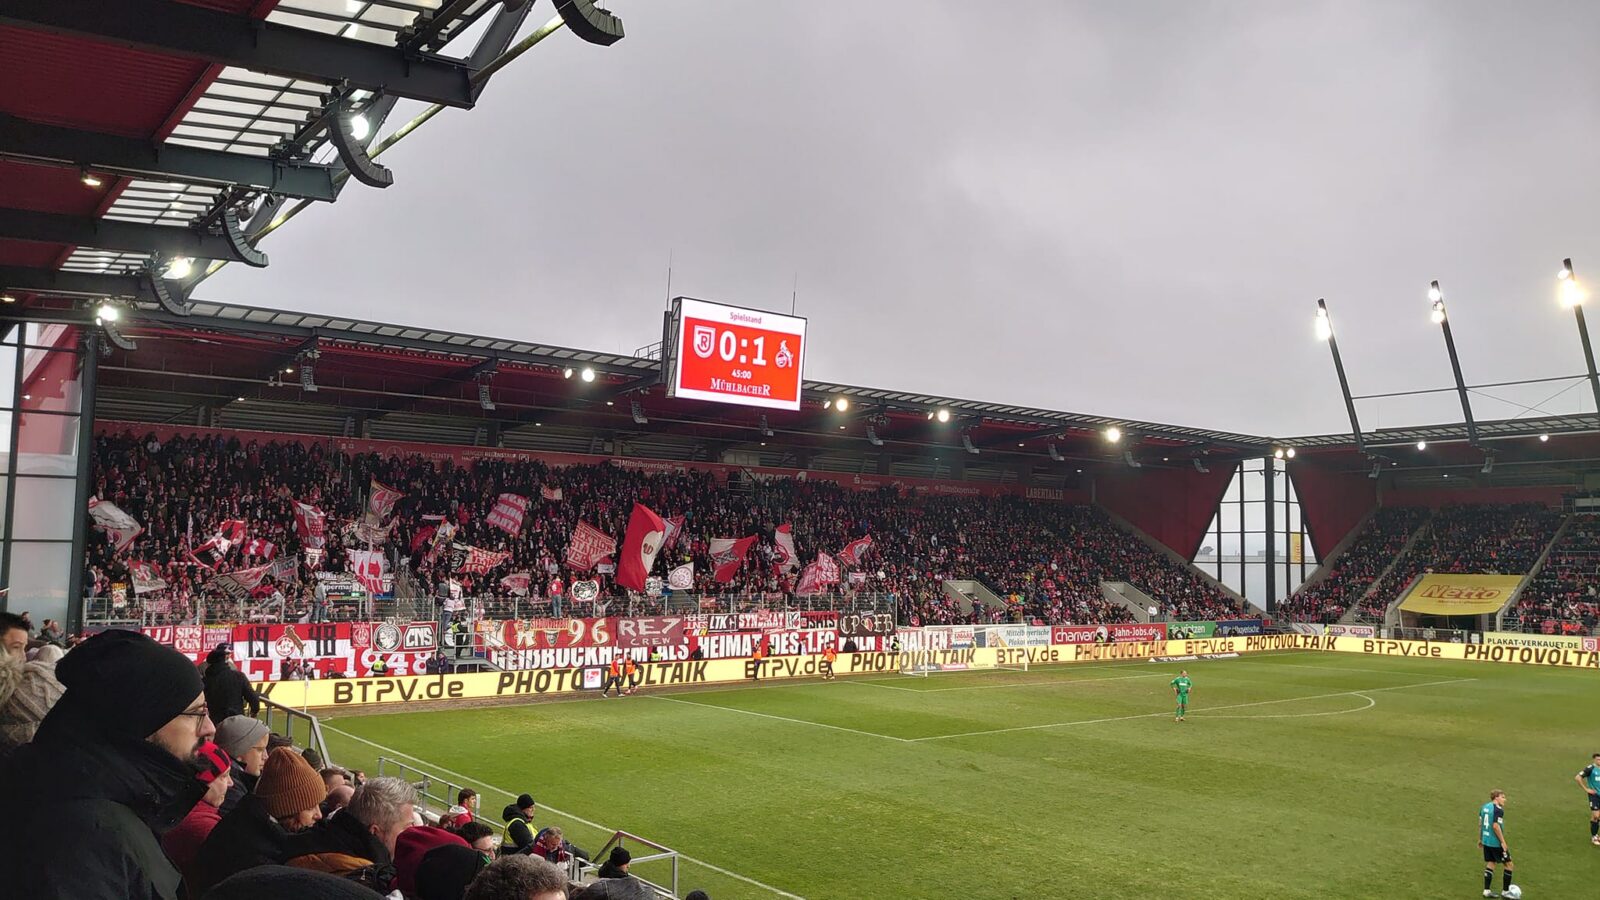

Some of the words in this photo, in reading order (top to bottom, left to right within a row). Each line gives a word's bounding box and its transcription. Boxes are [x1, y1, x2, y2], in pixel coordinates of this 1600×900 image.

[730, 312, 762, 324] Spielstand
[719, 330, 767, 366] 0:1
[731, 369, 752, 379] 45:00
[710, 377, 771, 396] MÜHLBACHER
[1025, 487, 1064, 500] LABERTALER
[1420, 584, 1500, 599] Netto
[710, 615, 728, 630] LTK
[175, 627, 202, 638] SPS
[405, 627, 433, 648] CNS
[1006, 629, 1049, 637] Mittelbyerische
[175, 638, 202, 650] CGN
[630, 637, 671, 646] CREW
[697, 634, 763, 658] HEIMAT
[334, 675, 464, 704] BTPV.de
[745, 654, 829, 679] BTPV.de
[997, 645, 1059, 664] BTPV.de
[1075, 641, 1168, 660] PHOTOVOLTAIK
[1185, 639, 1234, 653] BTPV.de
[1246, 634, 1337, 650] PHOTOVOLTAIK
[1363, 640, 1441, 658] BTPV.de
[1483, 813, 1490, 830] 4
